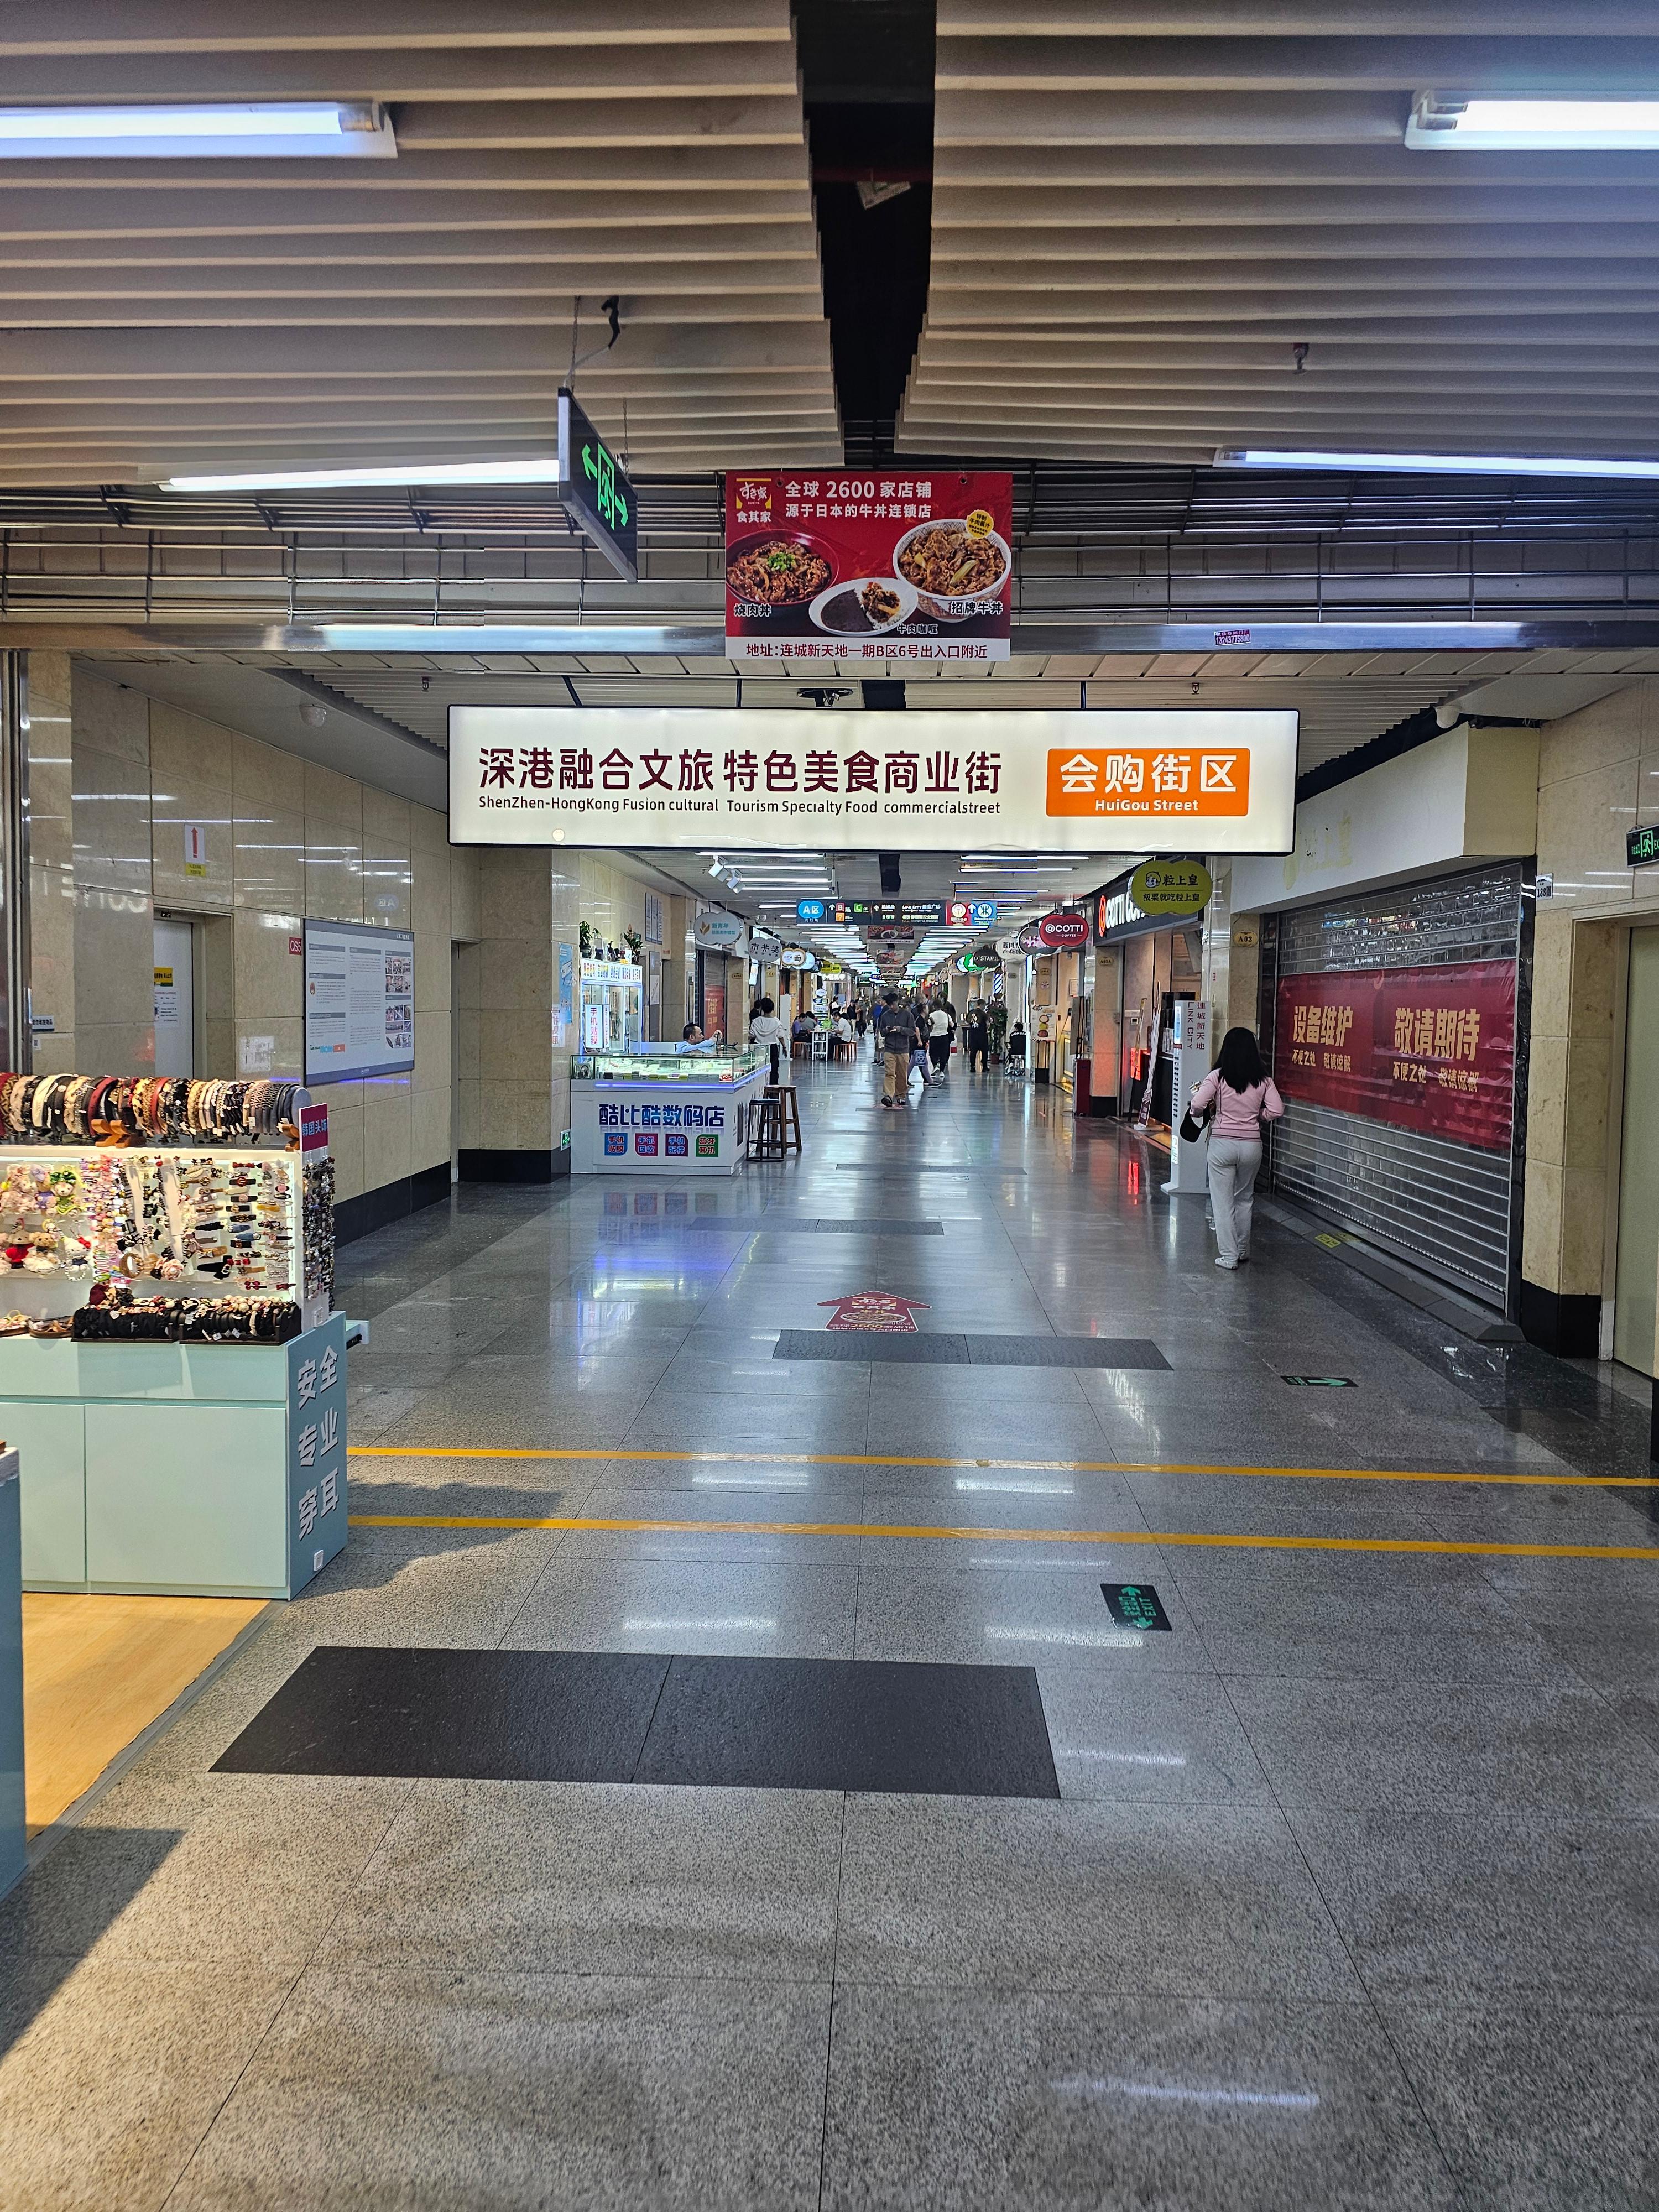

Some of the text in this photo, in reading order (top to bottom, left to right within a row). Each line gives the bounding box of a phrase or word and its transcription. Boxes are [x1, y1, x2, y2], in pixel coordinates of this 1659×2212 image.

[785, 481, 932, 498] 全球 2600 家店铺
[736, 510, 771, 523] 食其家
[785, 504, 931, 518] 源于日本的牛丼连锁店
[734, 603, 771, 617] 烧肉丼
[950, 601, 1003, 615] 招牌牛丼
[897, 623, 938, 634] 牛肉咖喱
[479, 747, 1002, 795] 深港融合文旅特色美食商业街
[1060, 754, 1238, 794] 会购街区
[479, 796, 1000, 817] ShenZhen-HongKong Fusion cultural Tourism Specialty Food commercialstreet
[1095, 798, 1198, 812] HuiGou Street
[1162, 874, 1198, 886] 粒上皇
[802, 905, 820, 914] A区
[289, 941, 301, 952] QS5
[1293, 1005, 1353, 1047] 设备维护
[1394, 1007, 1480, 1061] 敬请期待
[1292, 1049, 1351, 1072] 不便之处 敬请谅解
[1393, 1061, 1427, 1083] 不便之处
[599, 1104, 725, 1127] 酷比酷数码店
[298, 1345, 338, 1410] 安全
[298, 1407, 338, 1466] 专业
[299, 1467, 339, 1541] 穿耳
[1139, 1597, 1157, 1616] EXIT
